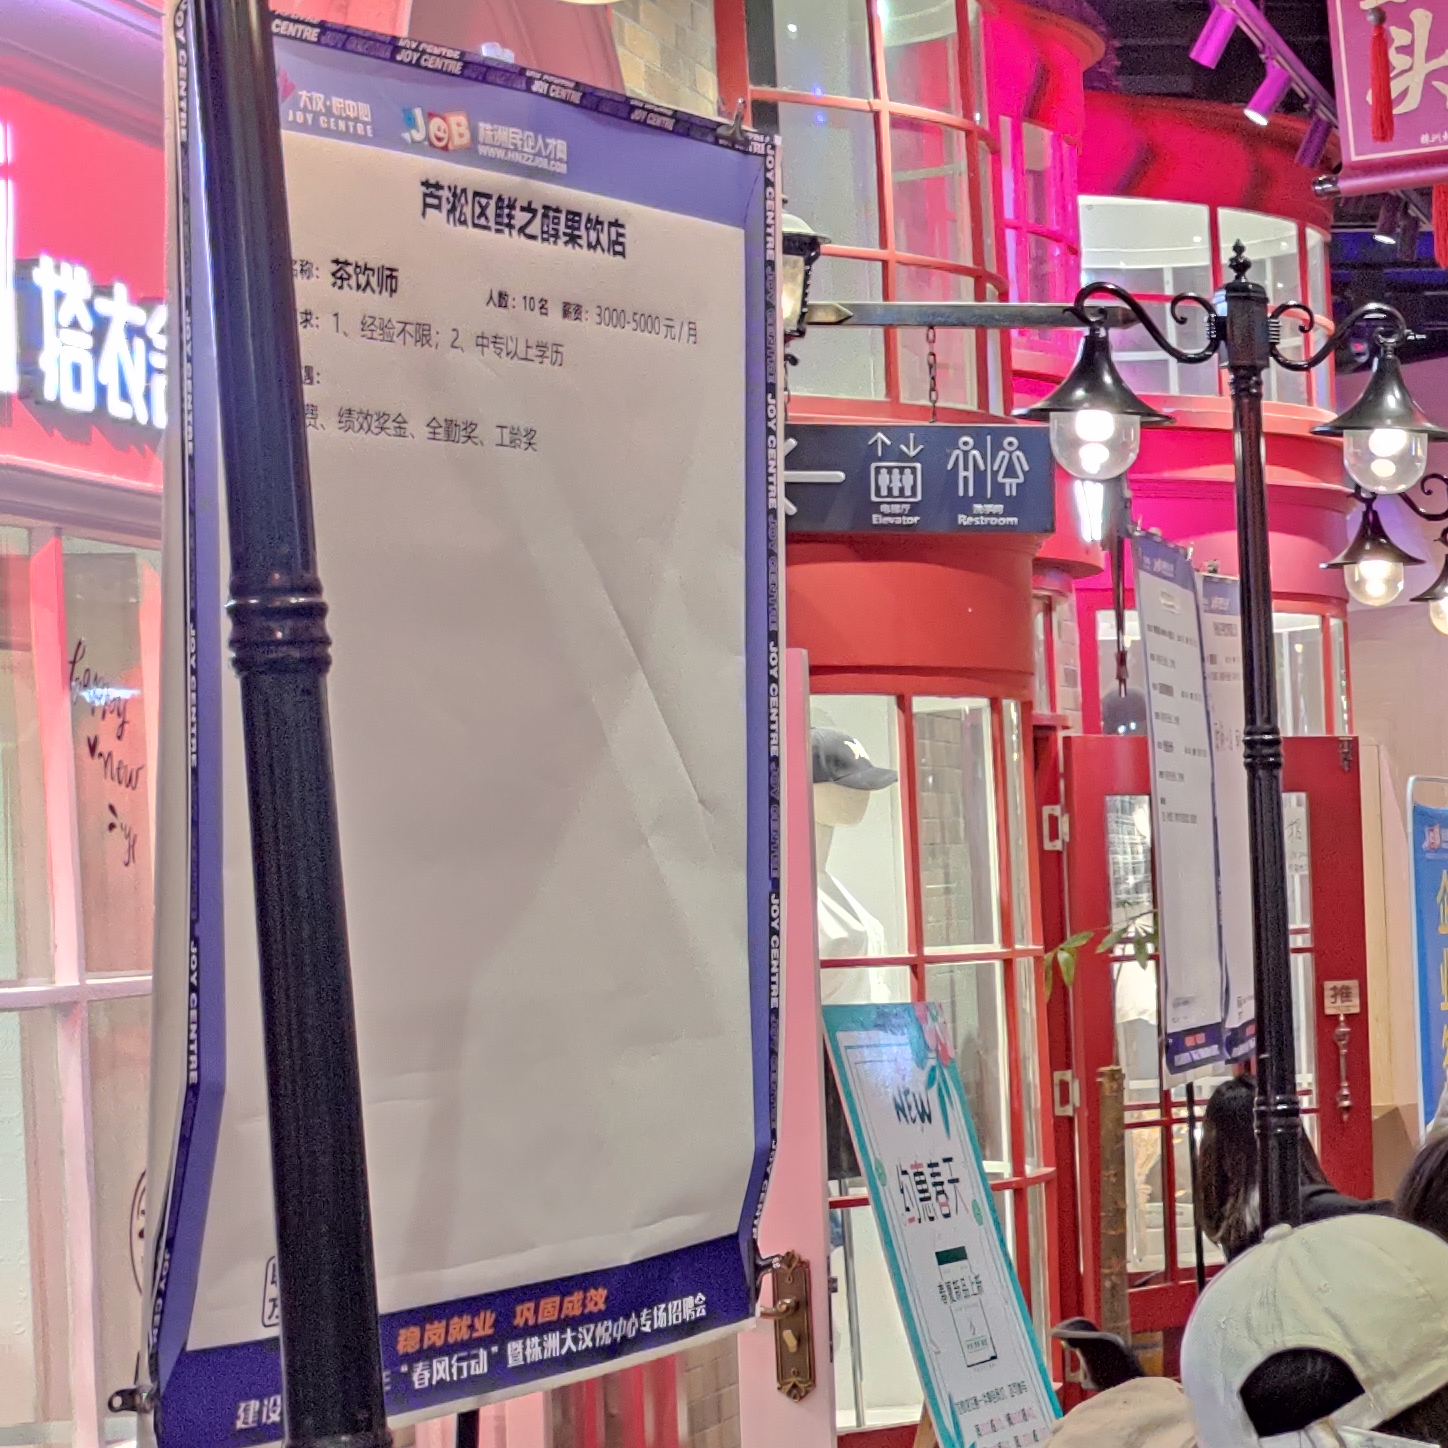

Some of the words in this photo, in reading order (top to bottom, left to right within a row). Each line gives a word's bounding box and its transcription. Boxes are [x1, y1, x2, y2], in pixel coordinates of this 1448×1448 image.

[271, 18, 319, 43] CENTRE
[396, 48, 420, 68] JOY
[421, 55, 463, 76] CENTRE
[177, 48, 188, 142] CENTRE
[530, 78, 547, 96] JOY
[549, 83, 582, 105] CENTRE
[288, 108, 314, 127] JOY
[318, 114, 374, 139] CENTRE
[766, 143, 776, 179] JOY
[420, 177, 628, 260] 芦淞区鲜之醇果饮店
[764, 182, 775, 261] CENTRE
[331, 258, 399, 299] 茶饮师
[767, 393, 777, 432] JOY
[766, 435, 777, 509] CENTRE
[871, 513, 921, 526] Elevator
[957, 513, 1019, 526] Restroom
[188, 622, 198, 671] JOY
[768, 641, 779, 676] JOY
[188, 675, 198, 768] CENTRE
[769, 678, 779, 755] CENTRE
[769, 892, 780, 931] JOY
[188, 939, 198, 987] JOY
[769, 933, 779, 1009] CENTRE
[1328, 984, 1354, 1005] 推
[188, 992, 198, 1088] CENTRE
[892, 1087, 932, 1125] NEW
[160, 1244, 173, 1289] JOY
[397, 1309, 496, 1355] 稳岗就业
[513, 1287, 609, 1327] 巩固成效
